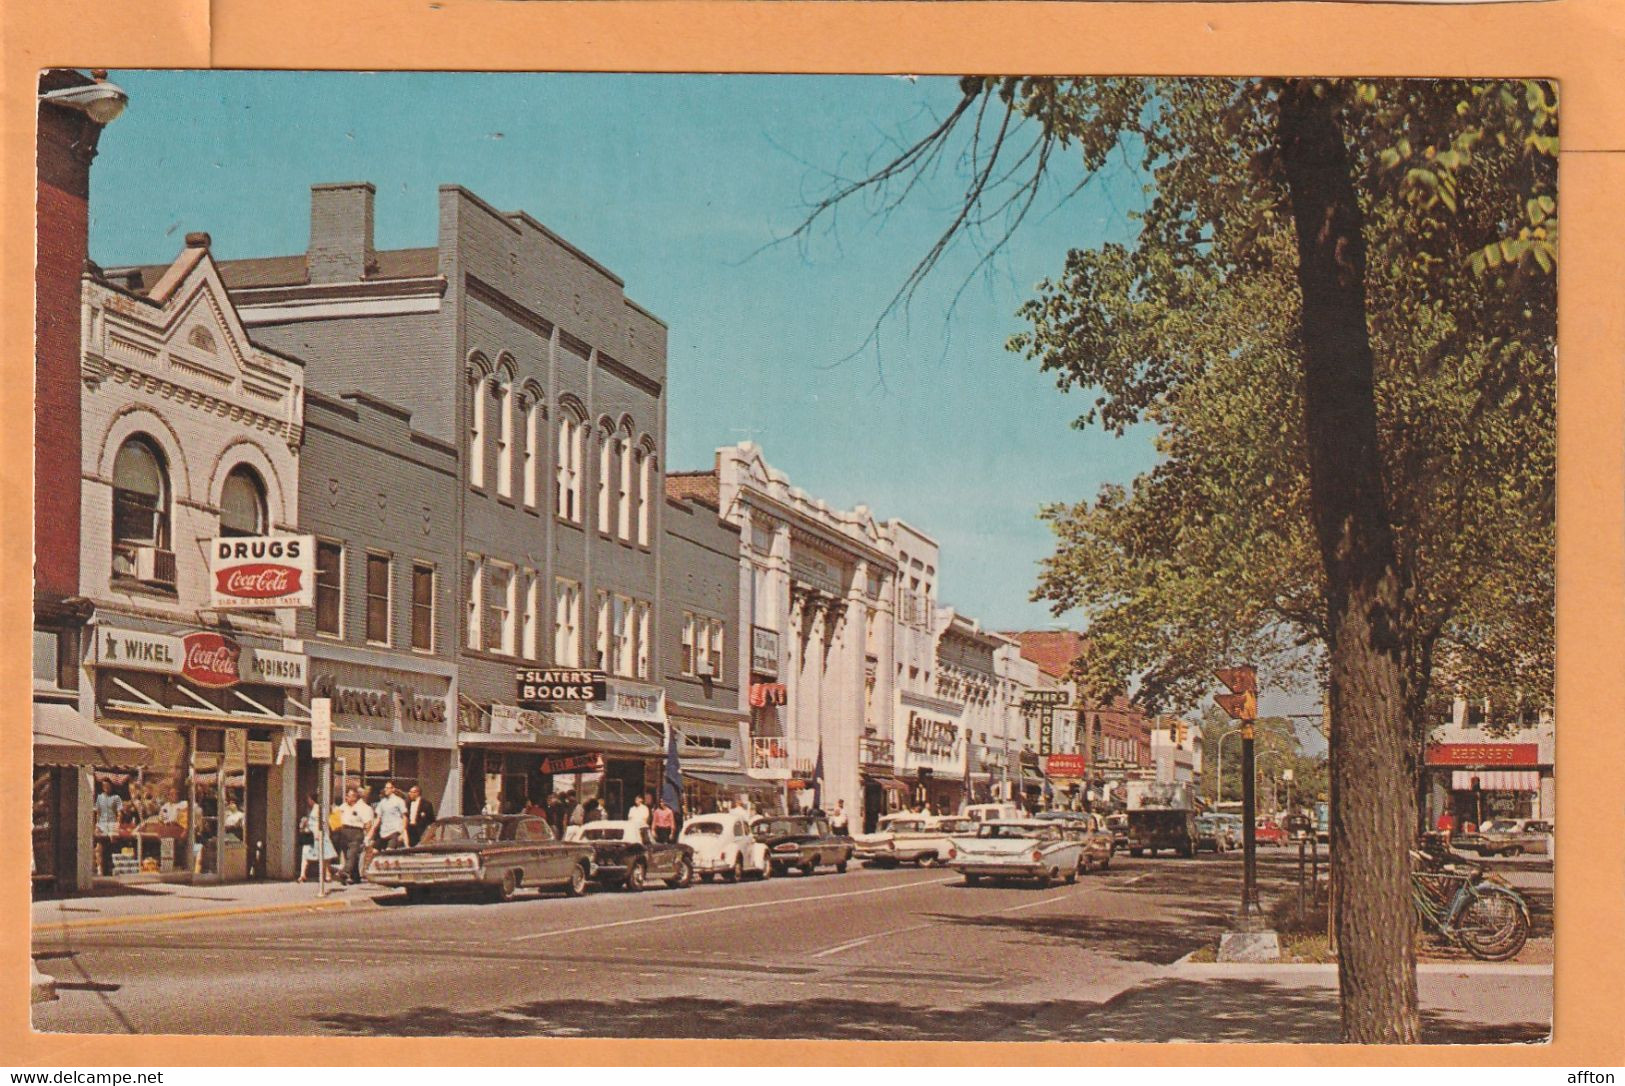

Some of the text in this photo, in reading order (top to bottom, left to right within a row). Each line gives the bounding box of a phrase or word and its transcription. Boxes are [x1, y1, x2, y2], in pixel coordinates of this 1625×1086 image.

[218, 541, 301, 560] DRUGS
[226, 567, 290, 592] Coca-Cola
[124, 638, 174, 664] WIKEL
[187, 643, 237, 675] Coca-Cola
[251, 656, 301, 679] ROBINSON
[526, 671, 593, 685] SLATER'S
[523, 686, 595, 699] BOOKS
